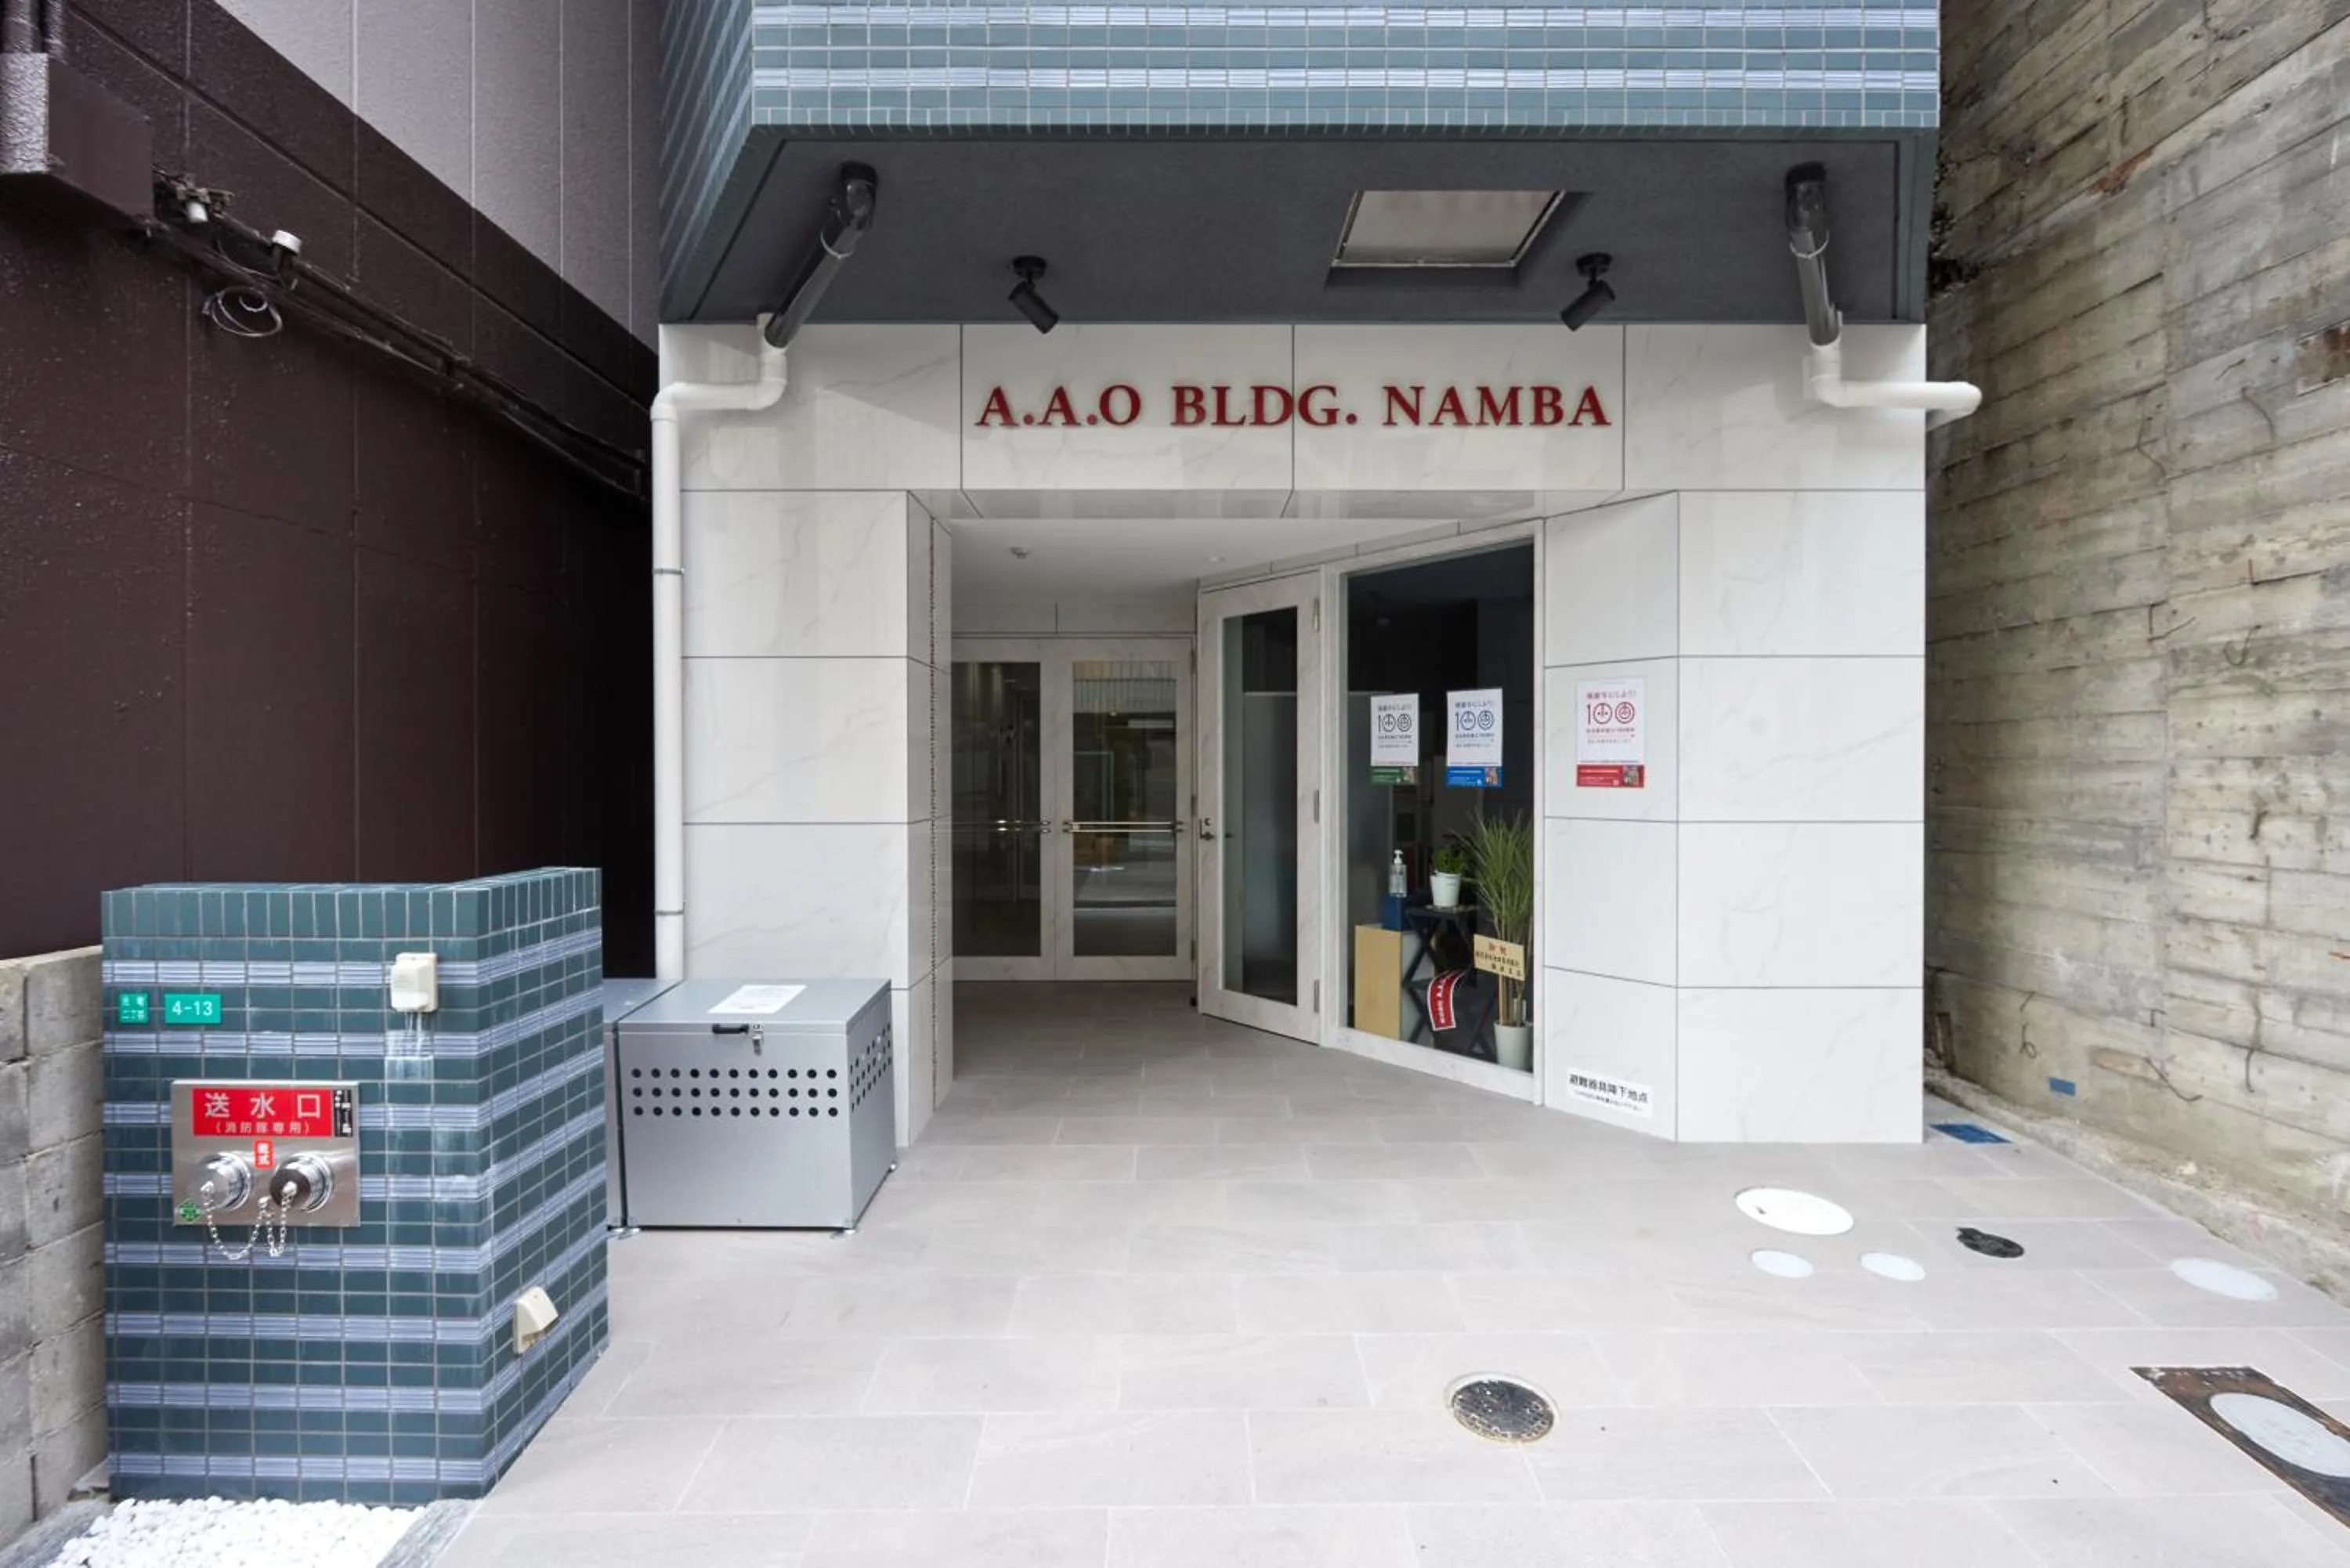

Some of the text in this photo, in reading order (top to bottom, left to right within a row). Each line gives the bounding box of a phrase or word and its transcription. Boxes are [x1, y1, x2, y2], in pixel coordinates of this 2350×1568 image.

[976, 385, 1612, 427] A.A.O BLDG. NAMBA
[172, 1000, 213, 1016] 4-13
[204, 1093, 321, 1119] 送水口
